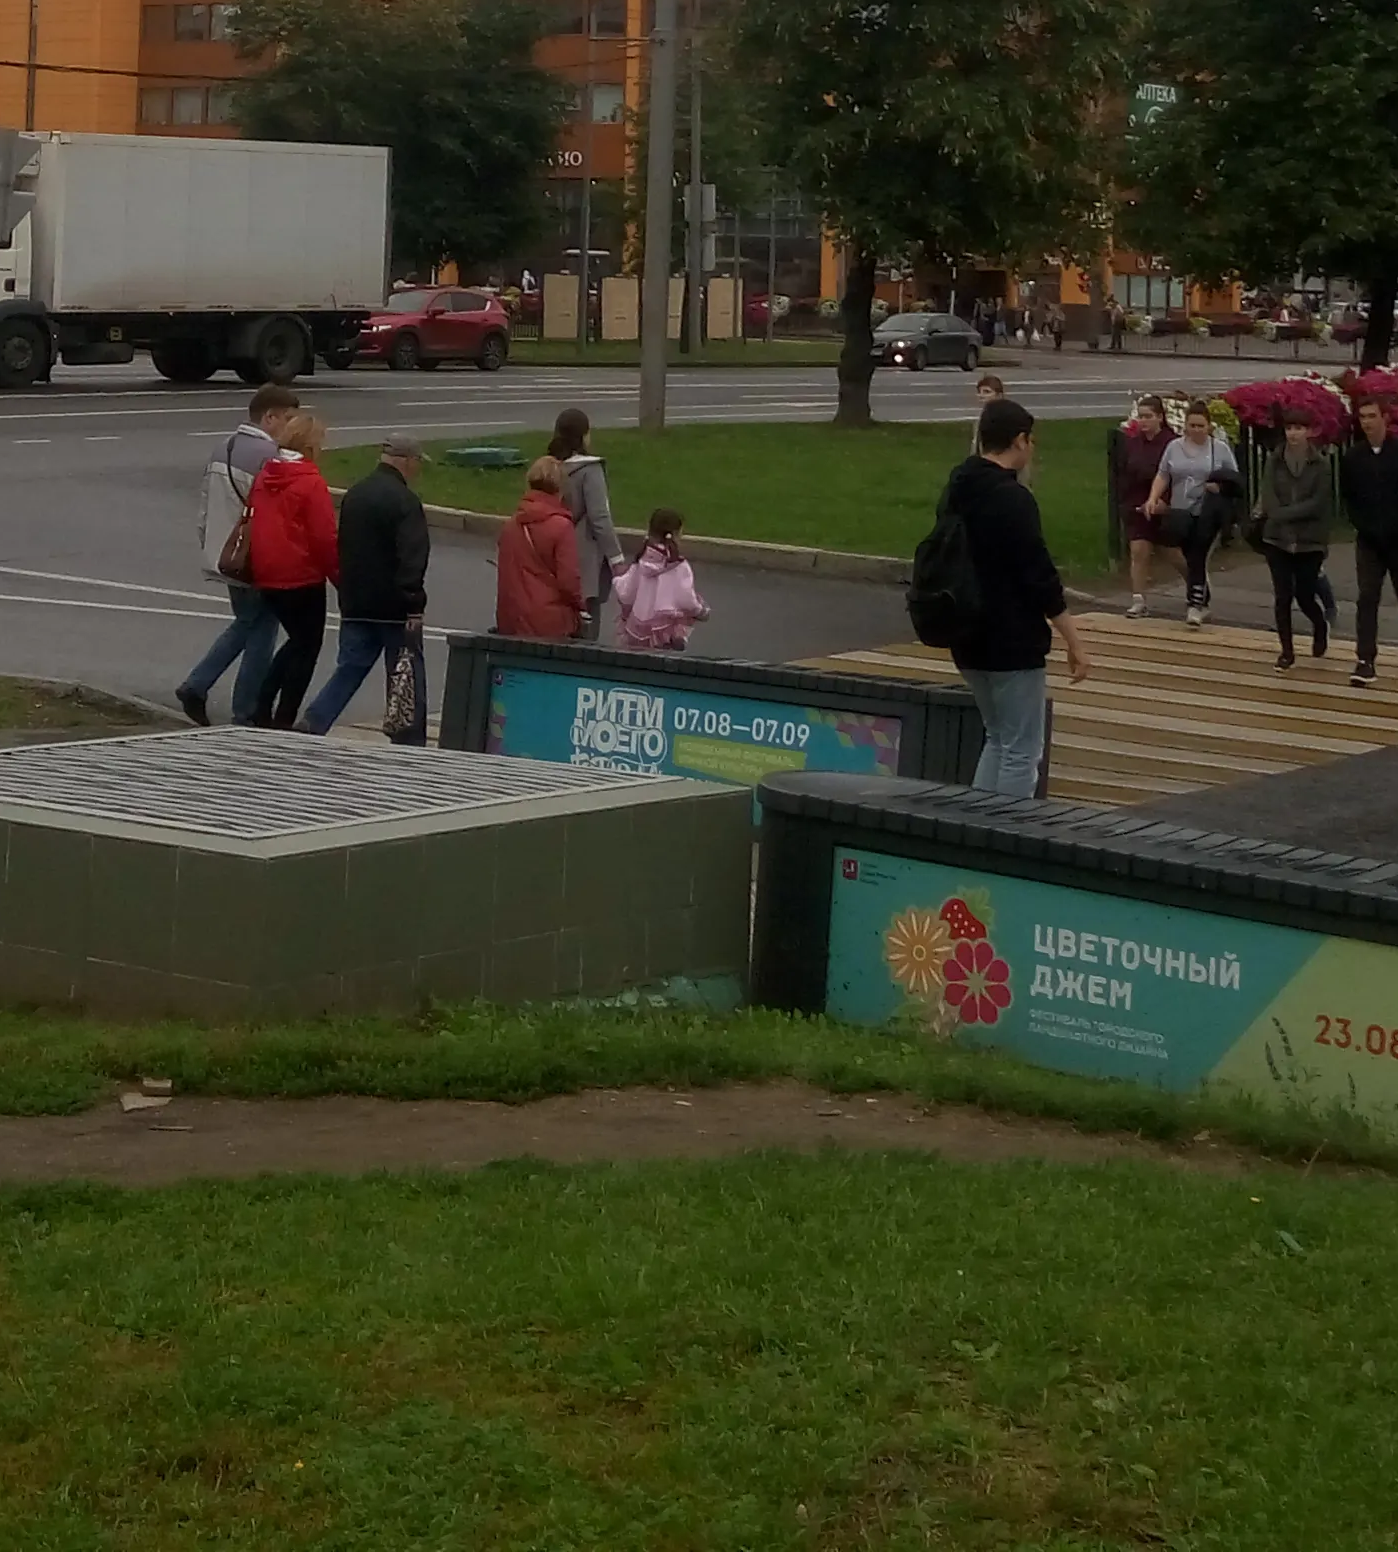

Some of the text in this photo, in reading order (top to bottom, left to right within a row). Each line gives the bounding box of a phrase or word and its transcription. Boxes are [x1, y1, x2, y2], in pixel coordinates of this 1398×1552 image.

[1135, 83, 1177, 103] АПТЕКА
[576, 687, 664, 730] РИТМ
[573, 718, 664, 758] МОЕГО
[1033, 923, 1241, 991] ЦВЕТОЧНЫЙ
[1029, 964, 1133, 1011] ДЖЕМ
